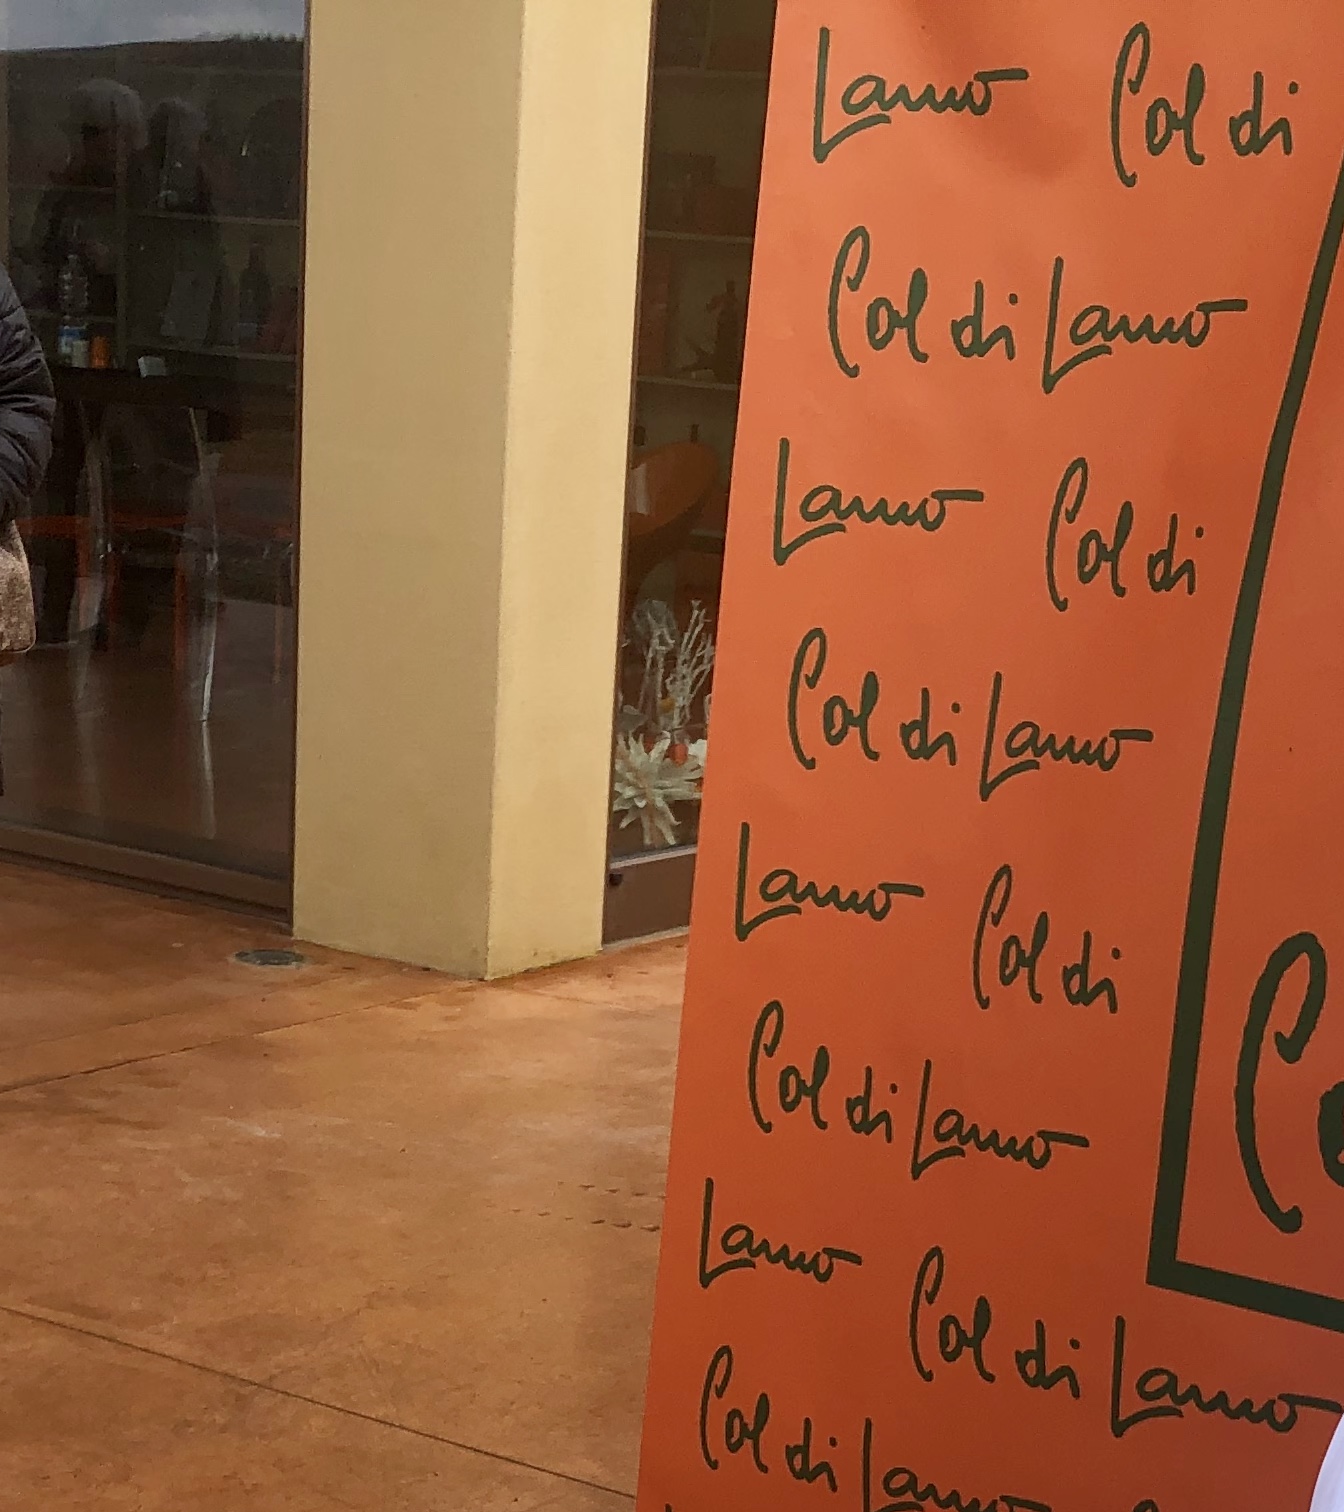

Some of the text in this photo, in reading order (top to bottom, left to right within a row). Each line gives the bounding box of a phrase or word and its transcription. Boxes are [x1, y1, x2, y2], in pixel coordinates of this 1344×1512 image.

[1111, 22, 1300, 187] Col di
[828, 226, 929, 378] Col
[950, 280, 1019, 360] di
[1046, 458, 1204, 611] Col di
[788, 627, 880, 770] Col
[899, 687, 961, 765] di
[972, 864, 1122, 1014] Col di
[748, 1001, 830, 1133] Col
[845, 1065, 898, 1144] di
[909, 1246, 996, 1382] Col
[1014, 1319, 1082, 1398] di
[699, 1345, 769, 1471] Col
[785, 1418, 838, 1493] di
